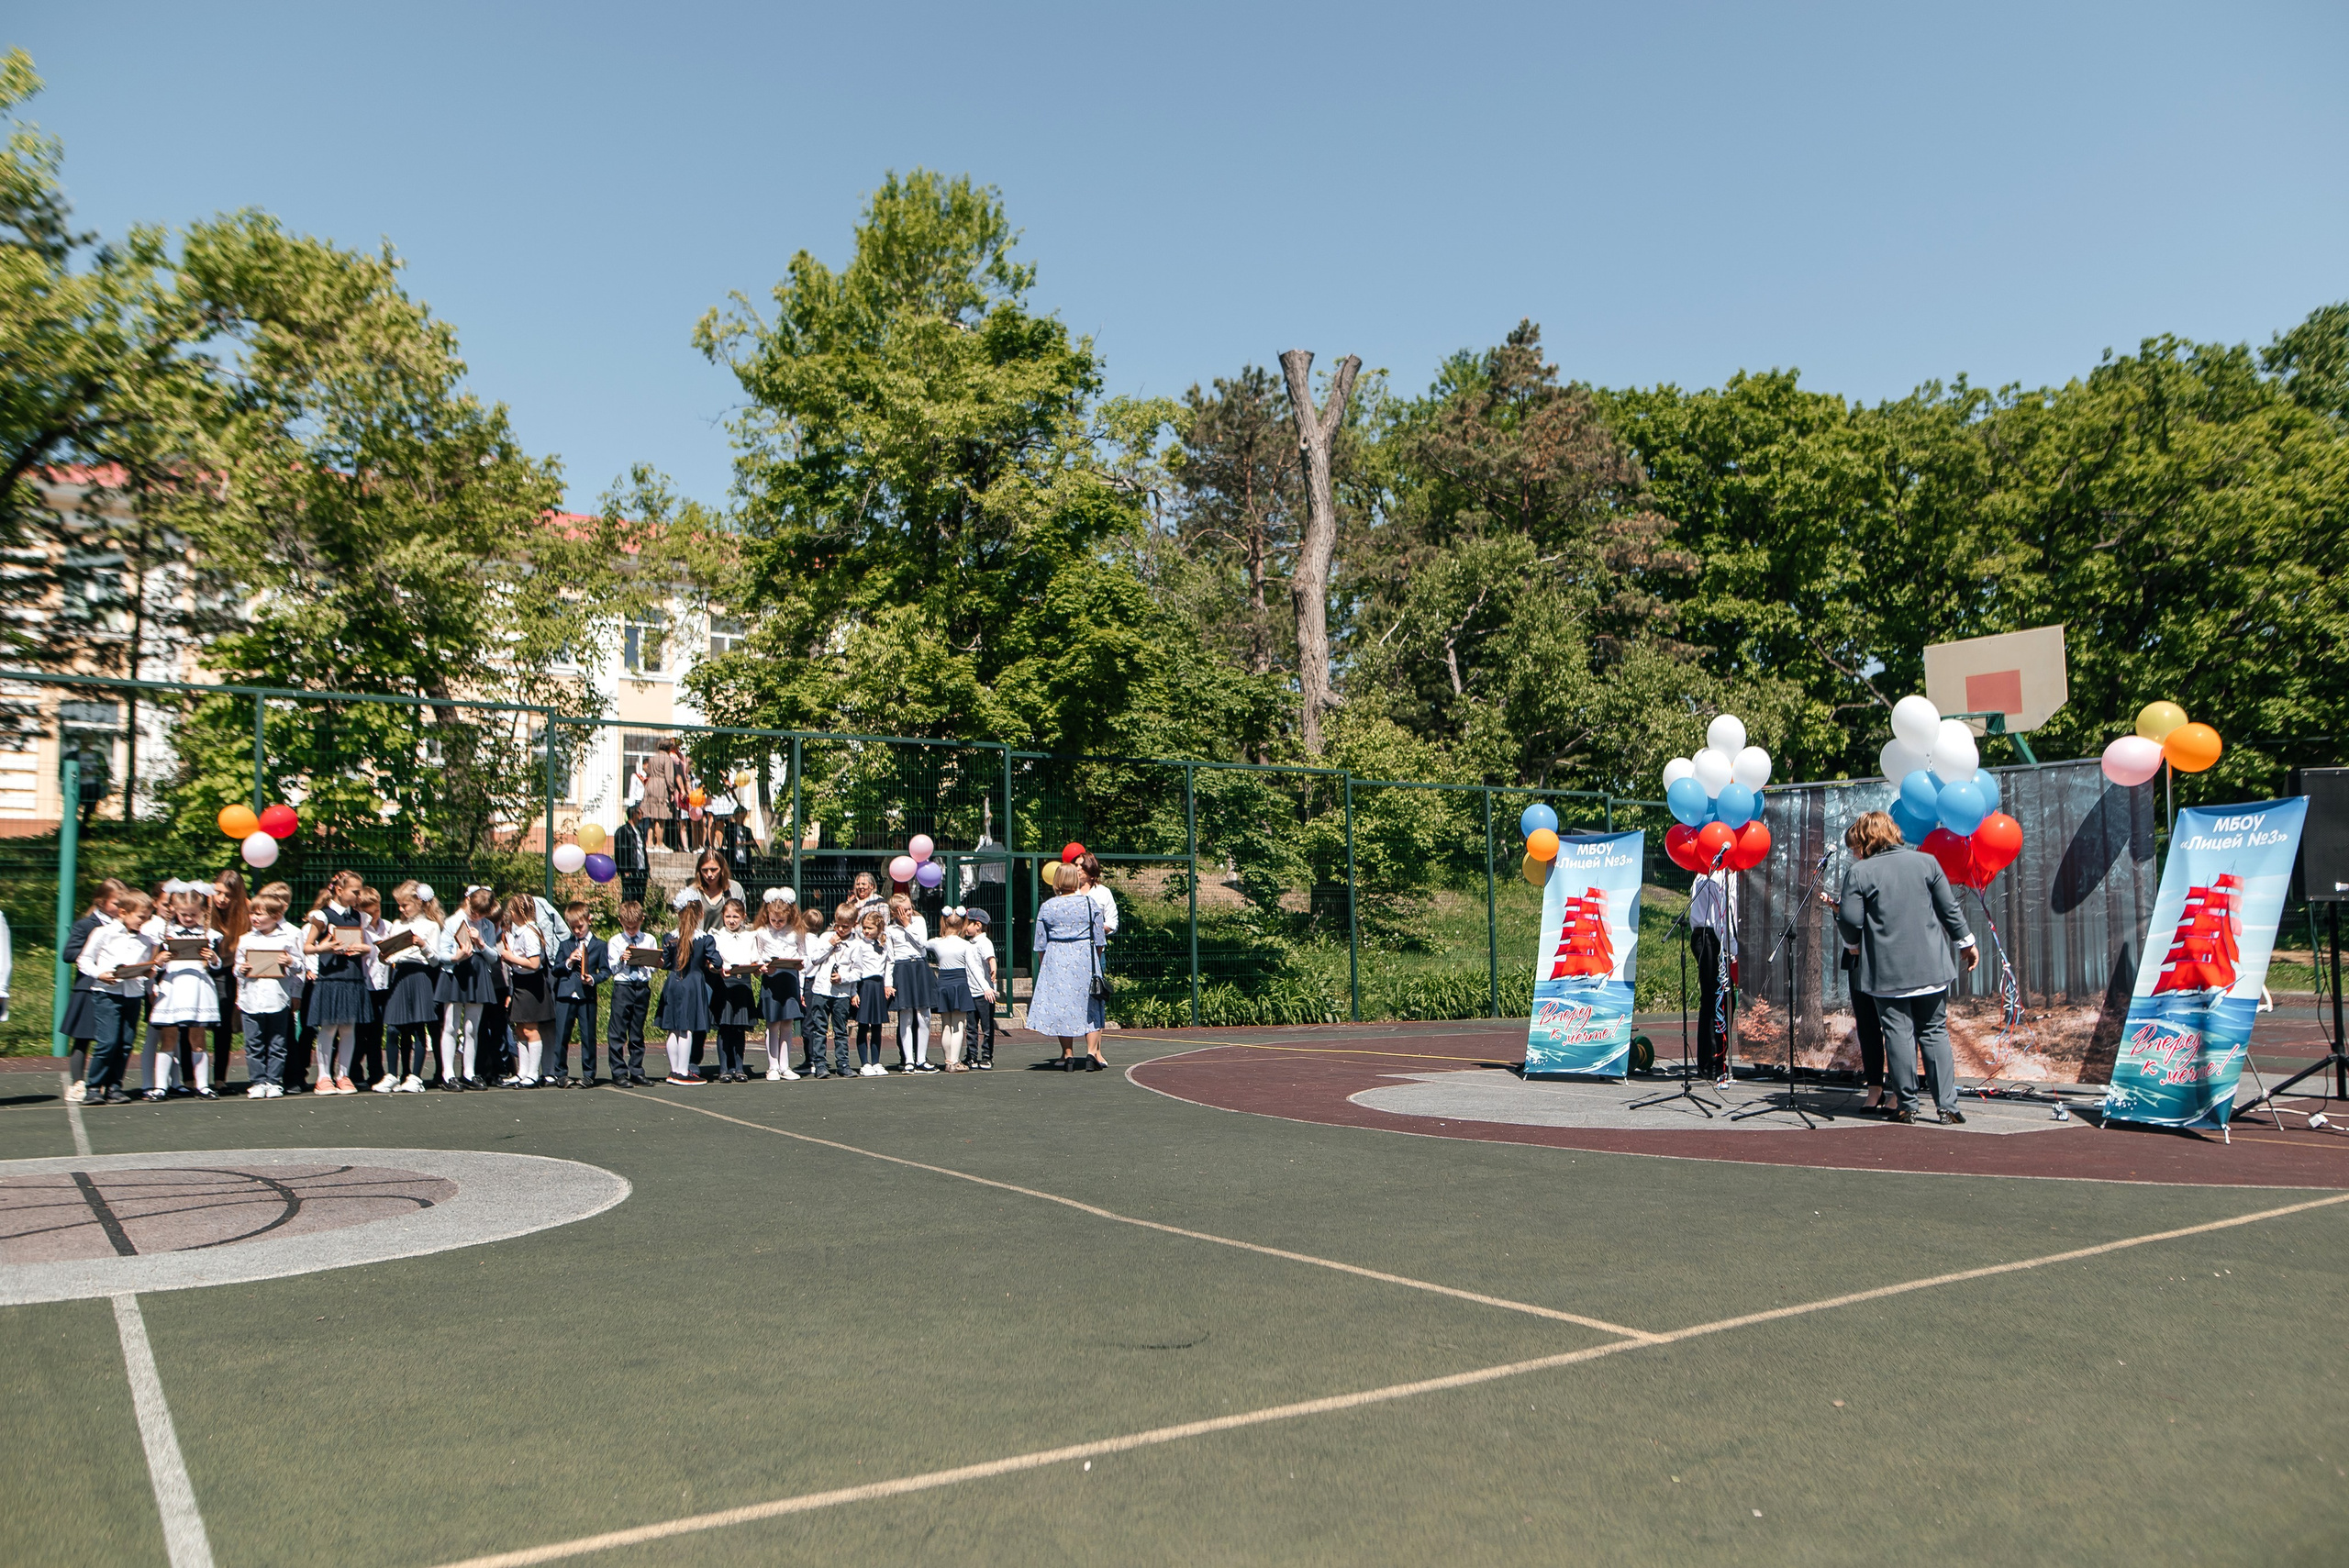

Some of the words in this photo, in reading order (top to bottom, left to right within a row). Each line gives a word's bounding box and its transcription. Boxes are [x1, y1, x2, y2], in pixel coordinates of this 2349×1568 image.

[2212, 814, 2266, 833] МБОУ
[1576, 842, 1615, 856] МБОУ
[2179, 833, 2243, 851] «Лицей
[2247, 828, 2288, 847] №3»
[1604, 854, 1633, 868] №3»
[1538, 1000, 1594, 1034] Вперед
[1562, 1014, 1625, 1046] мечте!
[2131, 1023, 2203, 1071] Вперед
